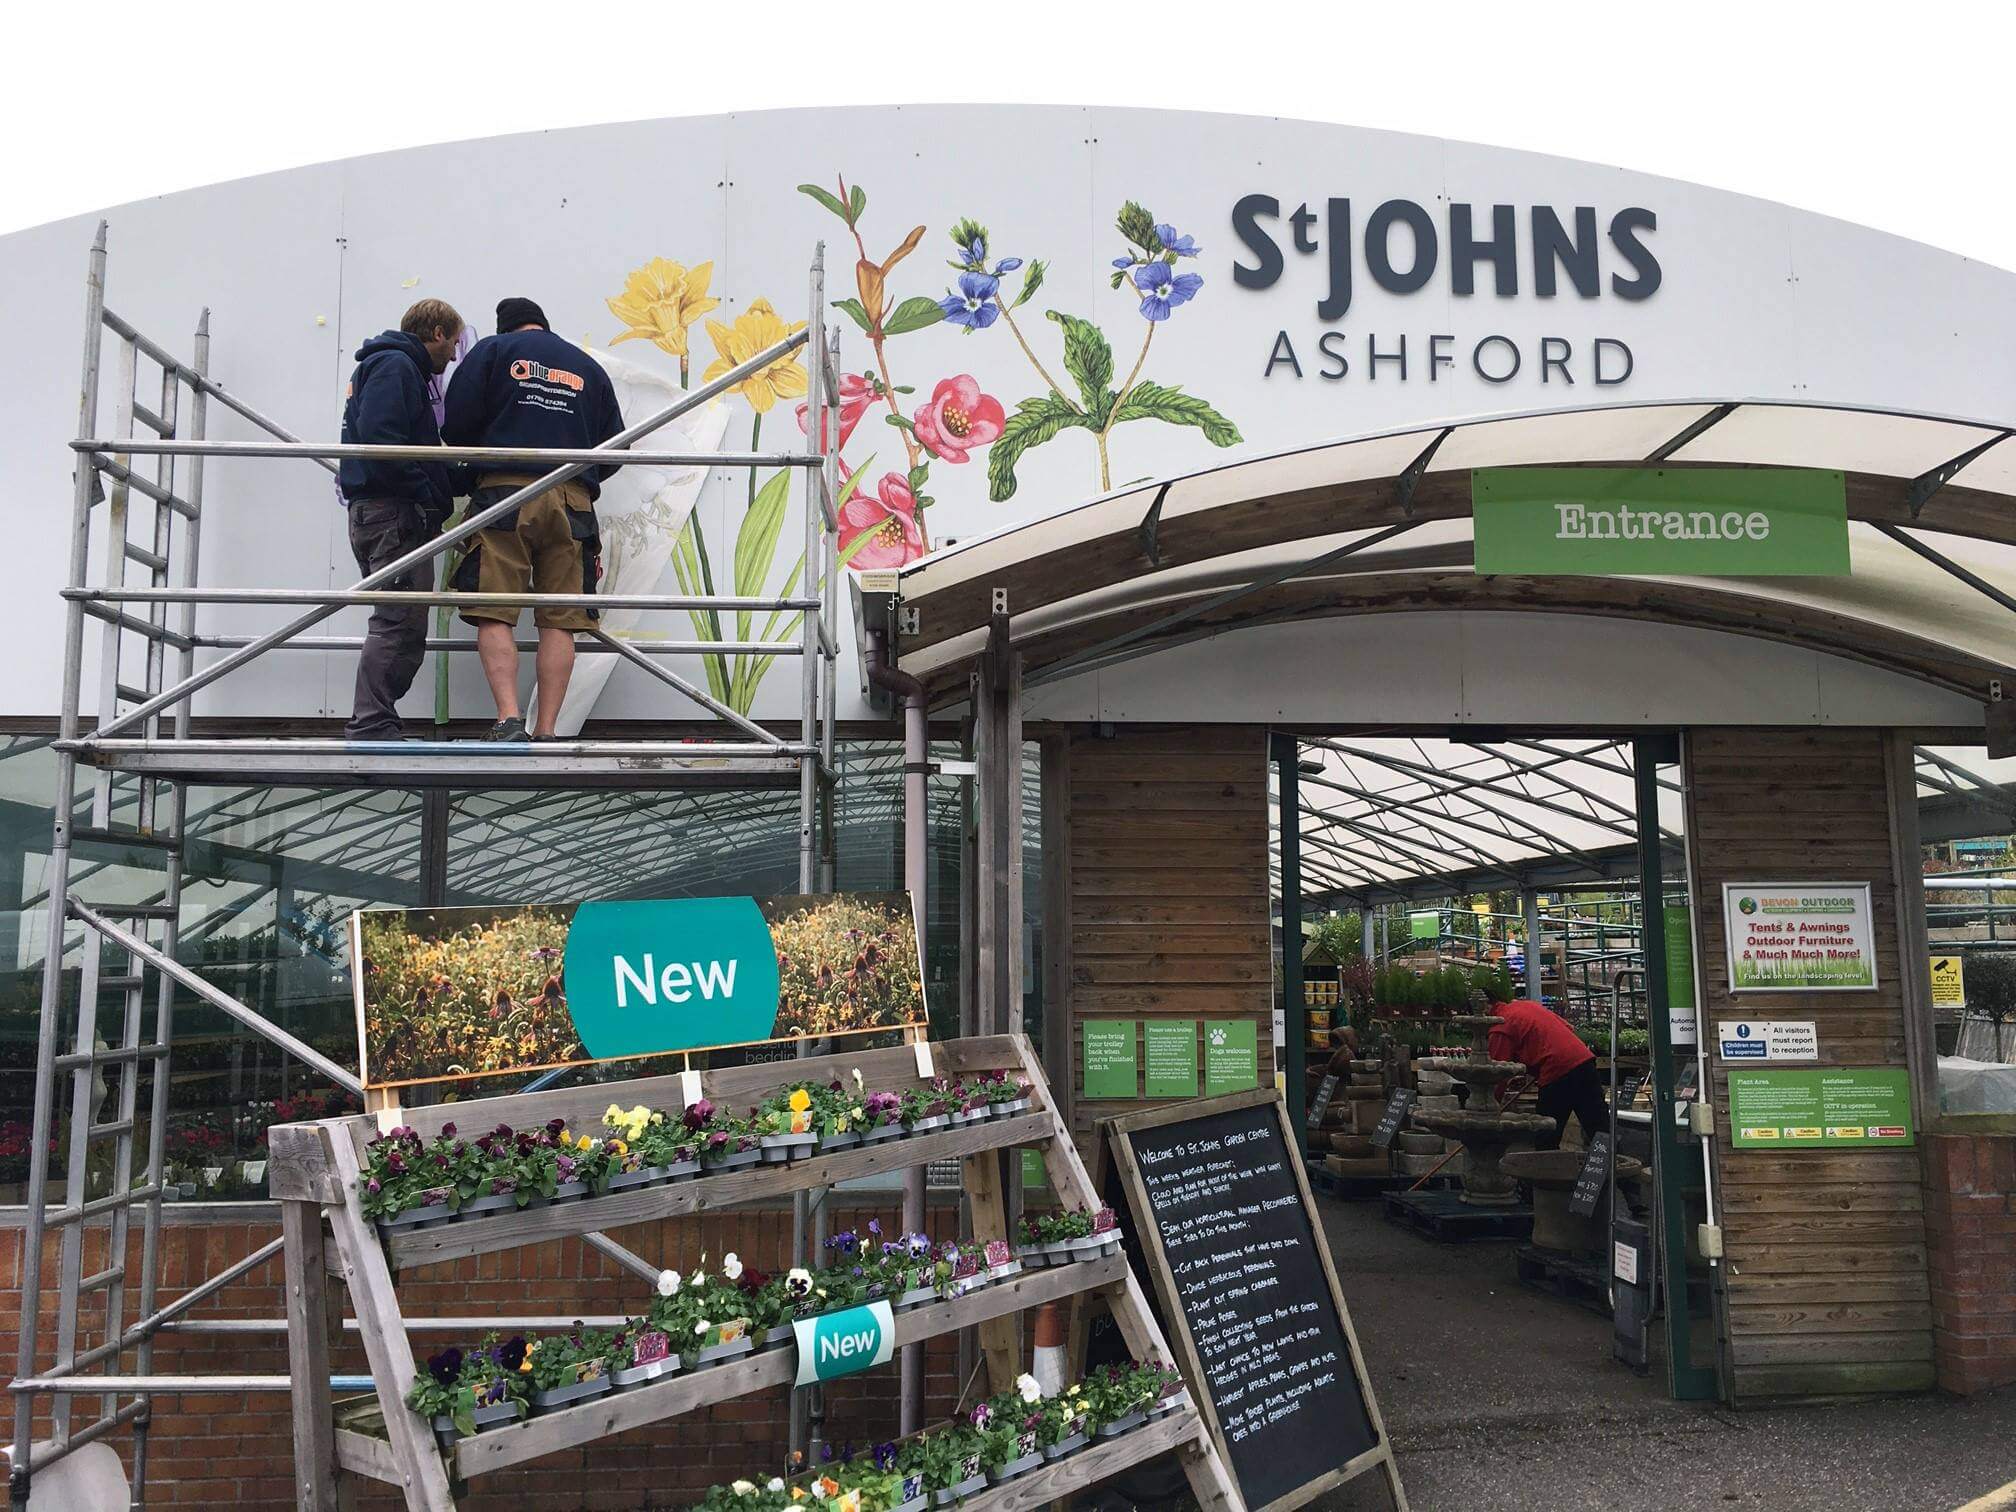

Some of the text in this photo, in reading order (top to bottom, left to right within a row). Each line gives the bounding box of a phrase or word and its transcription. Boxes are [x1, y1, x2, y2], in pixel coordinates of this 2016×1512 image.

[1264, 329, 1634, 387] ASHFORD
[1554, 503, 1770, 540] Entrance
[1760, 897, 1856, 907] DEVON OUTDOOR
[1748, 922, 1850, 934] Tents & Awnings
[1747, 936, 1854, 946] Outdoor Furniture
[1743, 949, 1861, 960] & Much Much More!
[614, 953, 738, 1008] New
[1798, 972, 1843, 980] landscaping
[745, 1050, 796, 1064] beddin
[1782, 1047, 1815, 1055] reception
[1138, 1148, 1174, 1165] WELCOME
[1175, 1144, 1186, 1156] TO
[1224, 1133, 1246, 1146] GARDEN
[1248, 1128, 1270, 1140] CENTRE
[1146, 1176, 1160, 1186] THIS
[1182, 1166, 1205, 1178] WEATHER
[1152, 1190, 1172, 1202] CLOUD
[1173, 1186, 1184, 1195] AND
[1185, 1183, 1197, 1192] RAIN
[1197, 1180, 1207, 1189] FOR
[1208, 1175, 1220, 1184] MOST
[1221, 1174, 1228, 1182] OF
[1228, 1172, 1238, 1180] THE
[1239, 1170, 1253, 1179] WEEK
[1154, 1200, 1172, 1210] SPELLS
[1201, 1188, 1212, 1196] AND
[1182, 1219, 1194, 1230] OUR
[1262, 1194, 1298, 1211] RECOMMENDS
[1166, 1238, 1182, 1248] THESE
[1184, 1234, 1198, 1242] JOBS
[1198, 1229, 1206, 1238] TO
[1206, 1228, 1215, 1236] DO
[1215, 1224, 1228, 1234] THIS
[1194, 1258, 1209, 1269] BACK
[1257, 1242, 1270, 1250] HAVE
[1271, 1240, 1283, 1249] DIED
[1214, 1293, 1225, 1305] OUT
[1228, 1286, 1249, 1299] SPRING
[1222, 1321, 1254, 1338] COLLECTING
[1255, 1314, 1274, 1326] SEEDS
[1274, 1308, 1288, 1320] FROM
[1289, 1305, 1299, 1314] THE
[1300, 1302, 1319, 1313] GARDEN
[820, 1328, 876, 1363] New
[1204, 1347, 1213, 1358] TO
[1213, 1342, 1226, 1354] SOW
[1228, 1336, 1241, 1347] NEXT
[1230, 1352, 1251, 1367] CHANCE
[1251, 1346, 1261, 1357] TO
[1262, 1342, 1274, 1353] MOW
[1276, 1334, 1294, 1347] LAWNS
[1296, 1330, 1308, 1340] AND
[1289, 1362, 1309, 1376] GRAPES
[1310, 1357, 1321, 1368] AND
[1214, 1370, 1239, 1387] HEDGES
[1285, 1382, 1312, 1399] INCLUDING
[1232, 1400, 1301, 1442] ONES INTO A GREENHOUSE
